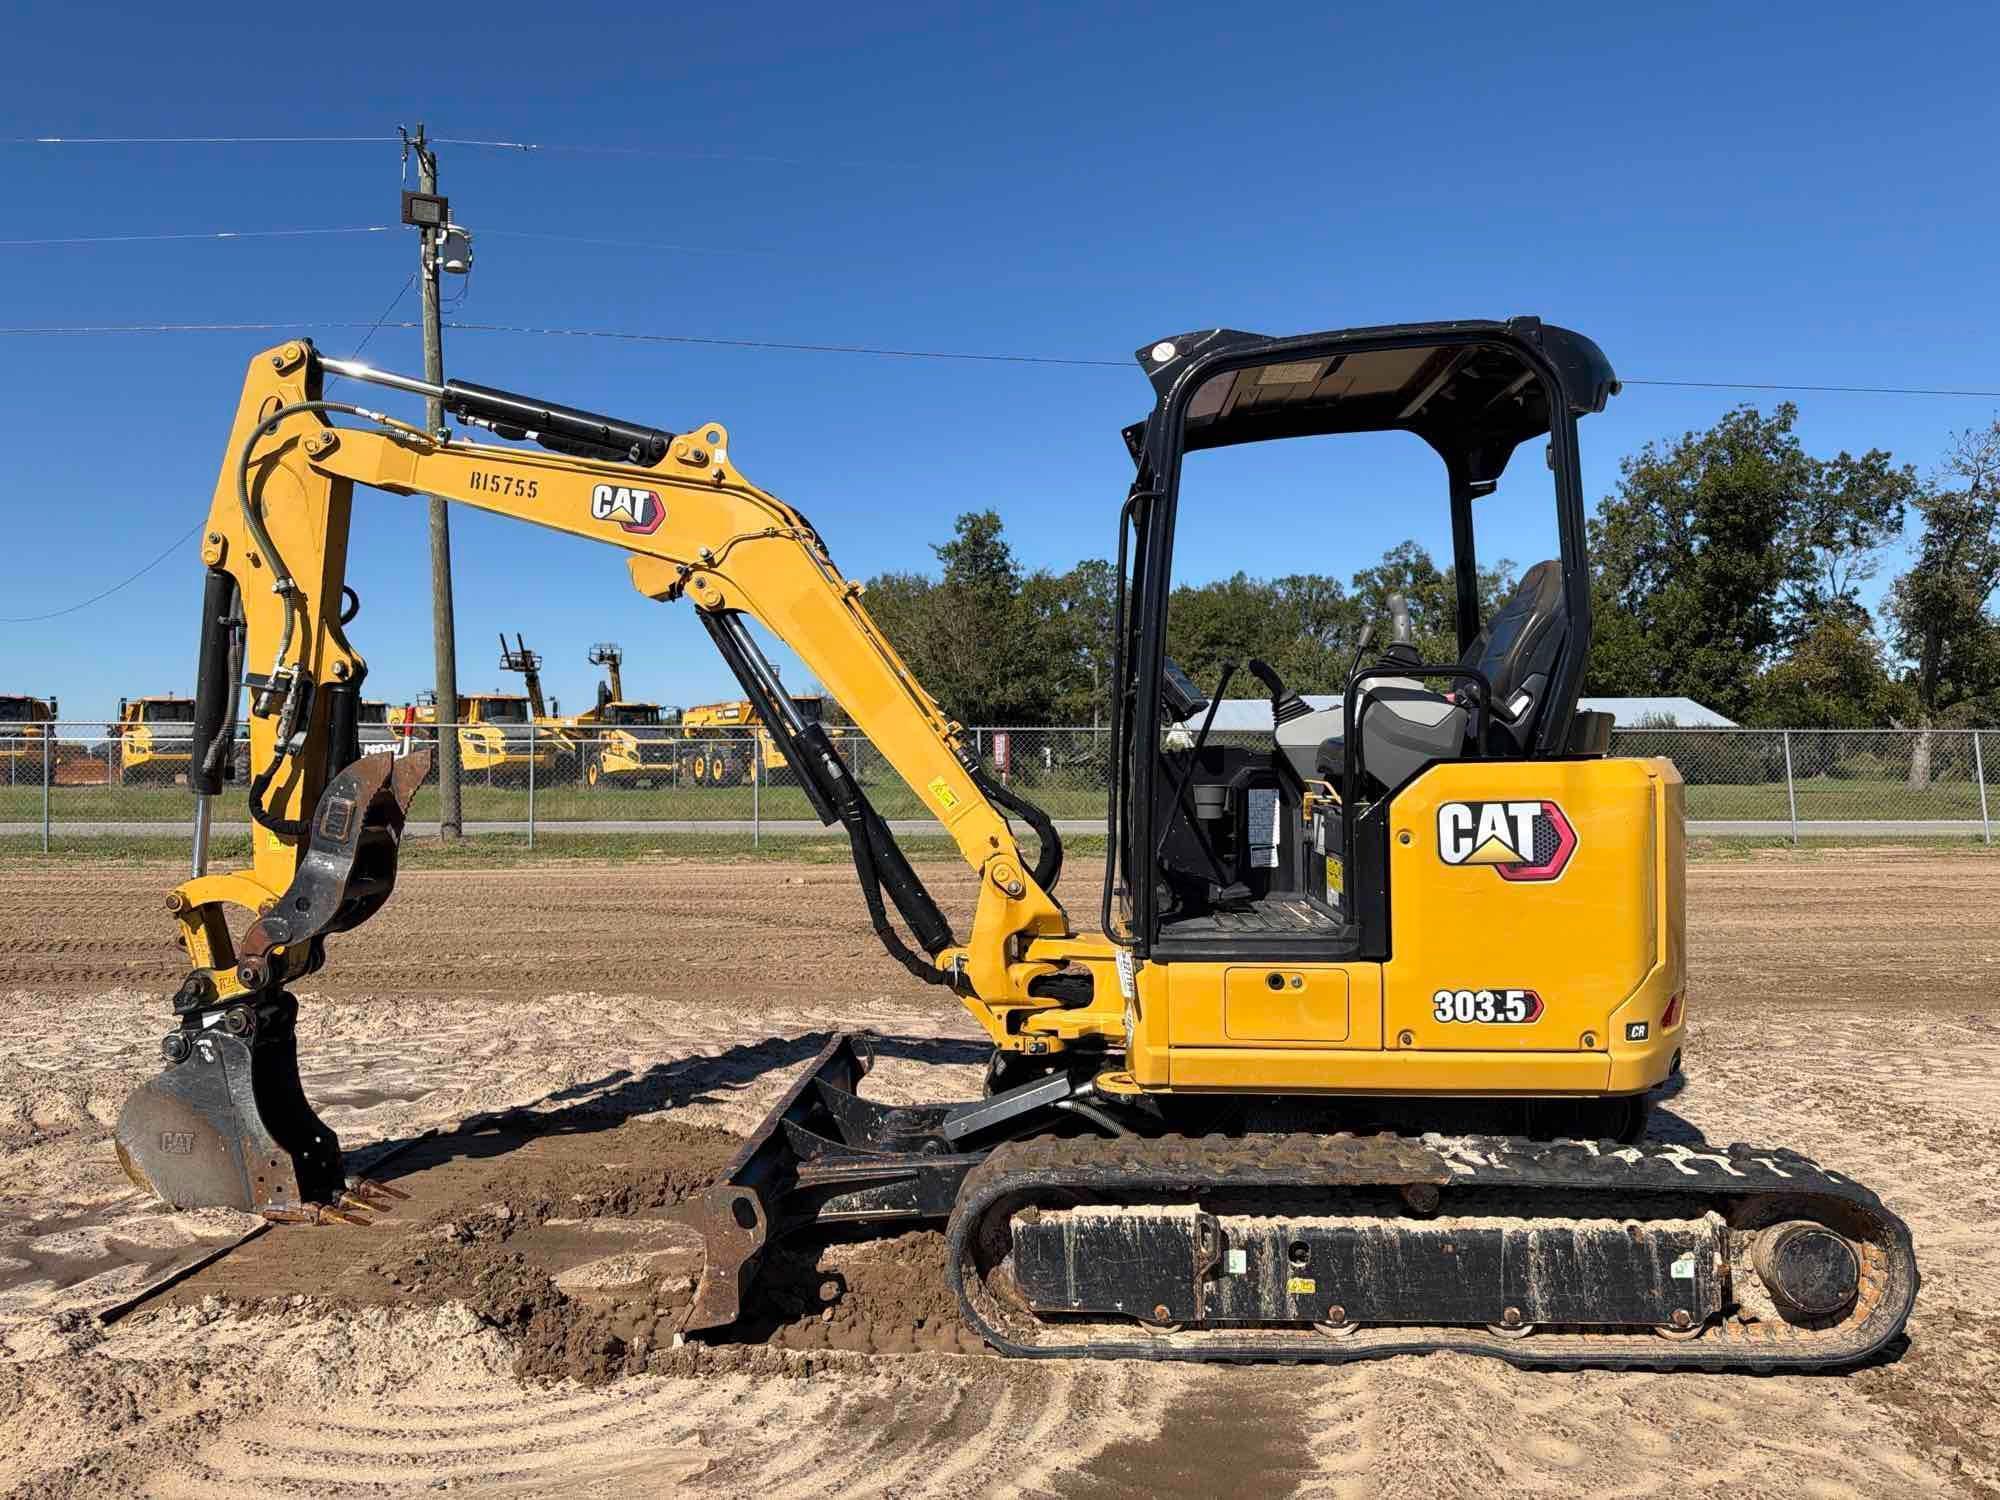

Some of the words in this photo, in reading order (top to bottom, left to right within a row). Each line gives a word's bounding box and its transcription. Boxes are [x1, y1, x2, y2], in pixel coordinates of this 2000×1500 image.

[593, 484, 651, 525] CAT
[1438, 802, 1542, 864] CAT
[1434, 990, 1525, 1022] 303.5
[1631, 1025, 1646, 1038] CR
[161, 1131, 194, 1153] CAT
